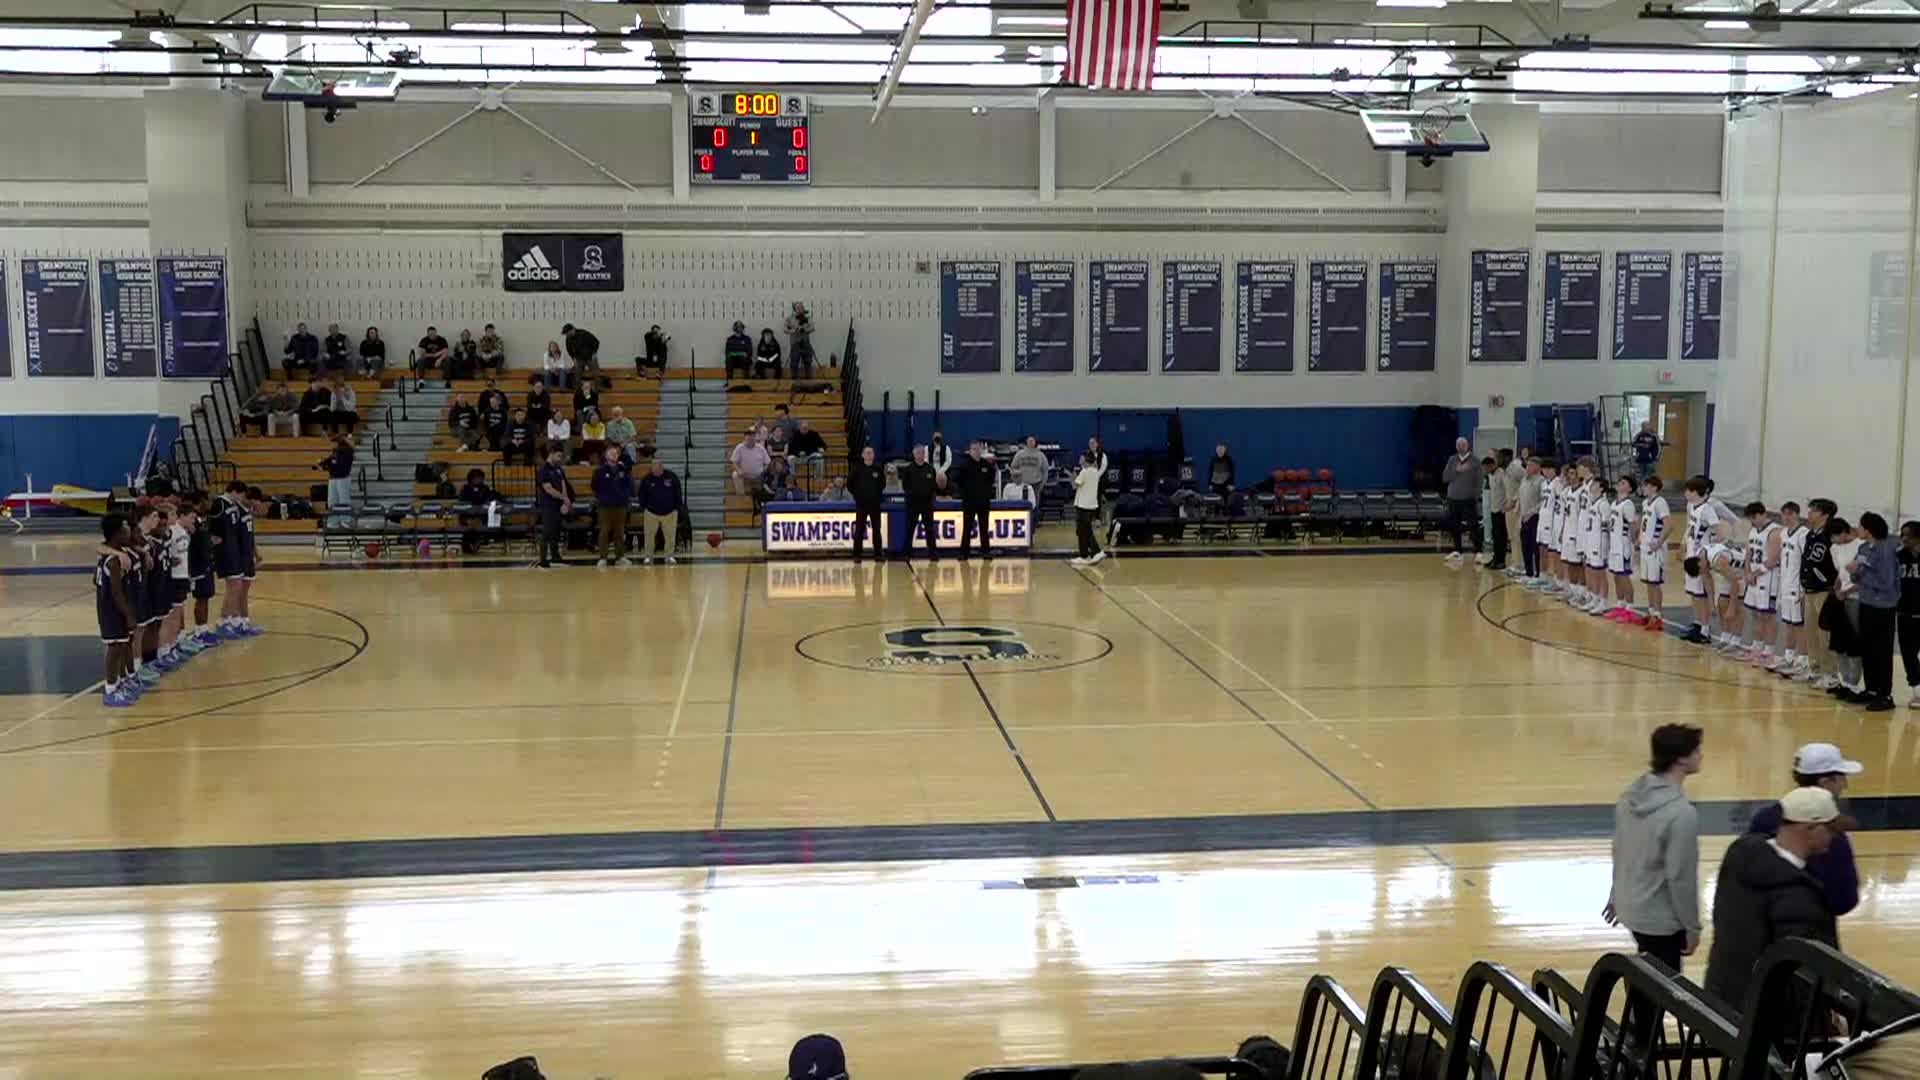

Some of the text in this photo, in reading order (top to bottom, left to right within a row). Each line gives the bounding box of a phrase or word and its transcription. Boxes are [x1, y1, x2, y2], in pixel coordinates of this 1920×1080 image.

[736, 95, 776, 114] 8:00
[692, 118, 736, 126] SWAMPSCOTT
[714, 128, 724, 146] 0
[750, 131, 756, 144] 1
[792, 128, 804, 148] 0
[701, 156, 710, 170] 0
[795, 156, 804, 170] 0
[38, 262, 88, 272] SWAMPSCOTT
[115, 262, 152, 272] SWAMPSC
[174, 261, 222, 270] SWAMPSCOTT
[176, 271, 219, 279] HIGH SCHOOL
[508, 268, 560, 280] adidas
[40, 272, 86, 280] HIGH SCHOOL
[117, 272, 133, 280] HIGH
[1618, 270, 1626, 294] TRACK
[1688, 266, 1696, 290] TRACK
[1166, 278, 1174, 302] TRACK
[1312, 280, 1321, 326] LACROSSE
[1381, 296, 1390, 330] SOCCER
[1473, 280, 1482, 346] GIRLS SOCCER
[26, 290, 40, 358] FIELD HOCKEY
[1018, 295, 1027, 355] BOYS HOCKEY
[1239, 285, 1248, 355] BOYS LACROSSE
[1546, 298, 1556, 344] SOFTBALL
[104, 310, 117, 358] FOOTBALL
[164, 321, 174, 360] FOOTBALL
[944, 333, 953, 356] GOLF
